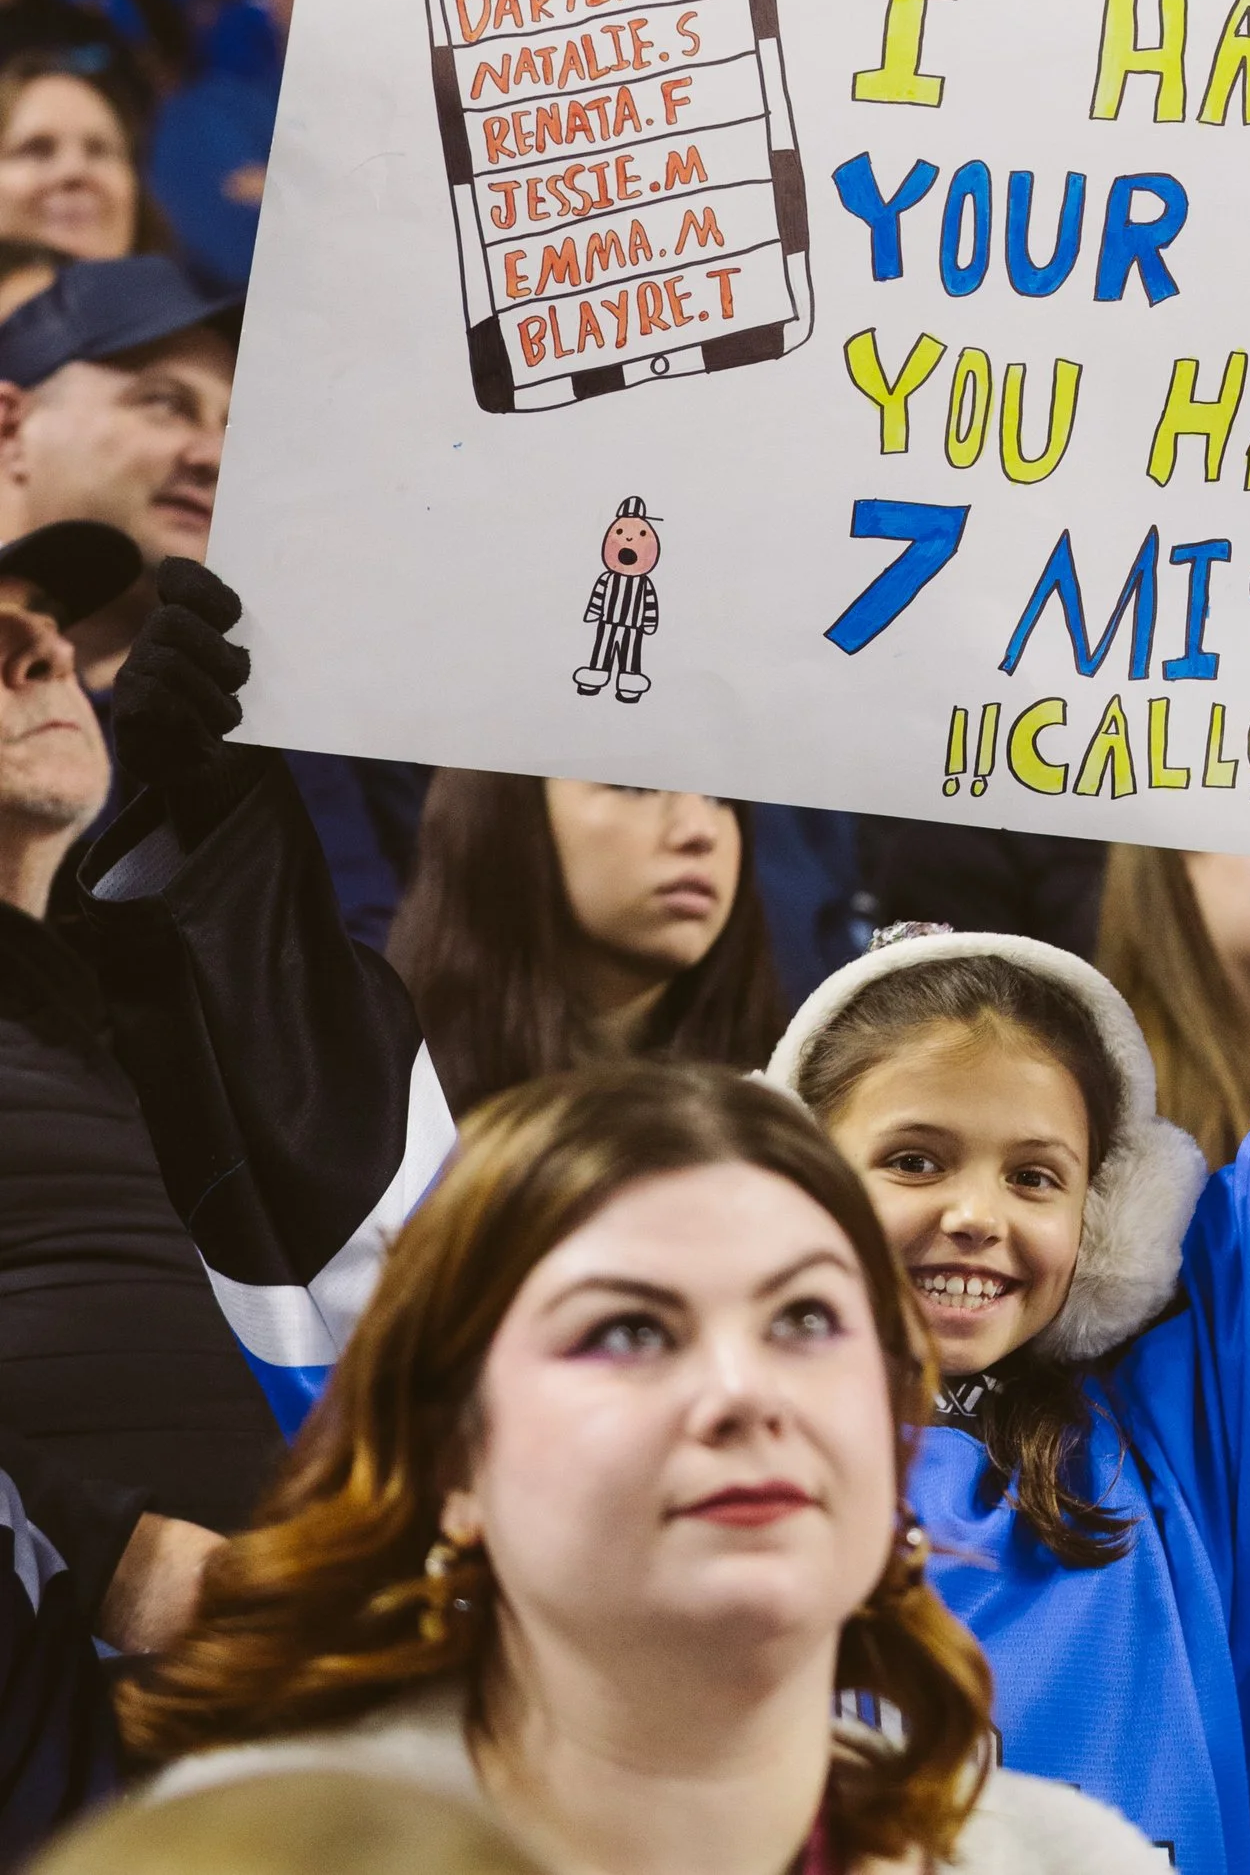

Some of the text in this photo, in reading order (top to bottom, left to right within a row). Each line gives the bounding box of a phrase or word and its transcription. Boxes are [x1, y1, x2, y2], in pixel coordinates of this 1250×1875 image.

[832, 151, 1189, 308] YOUR
[843, 328, 1083, 485] YOU
[823, 499, 971, 655] 7
